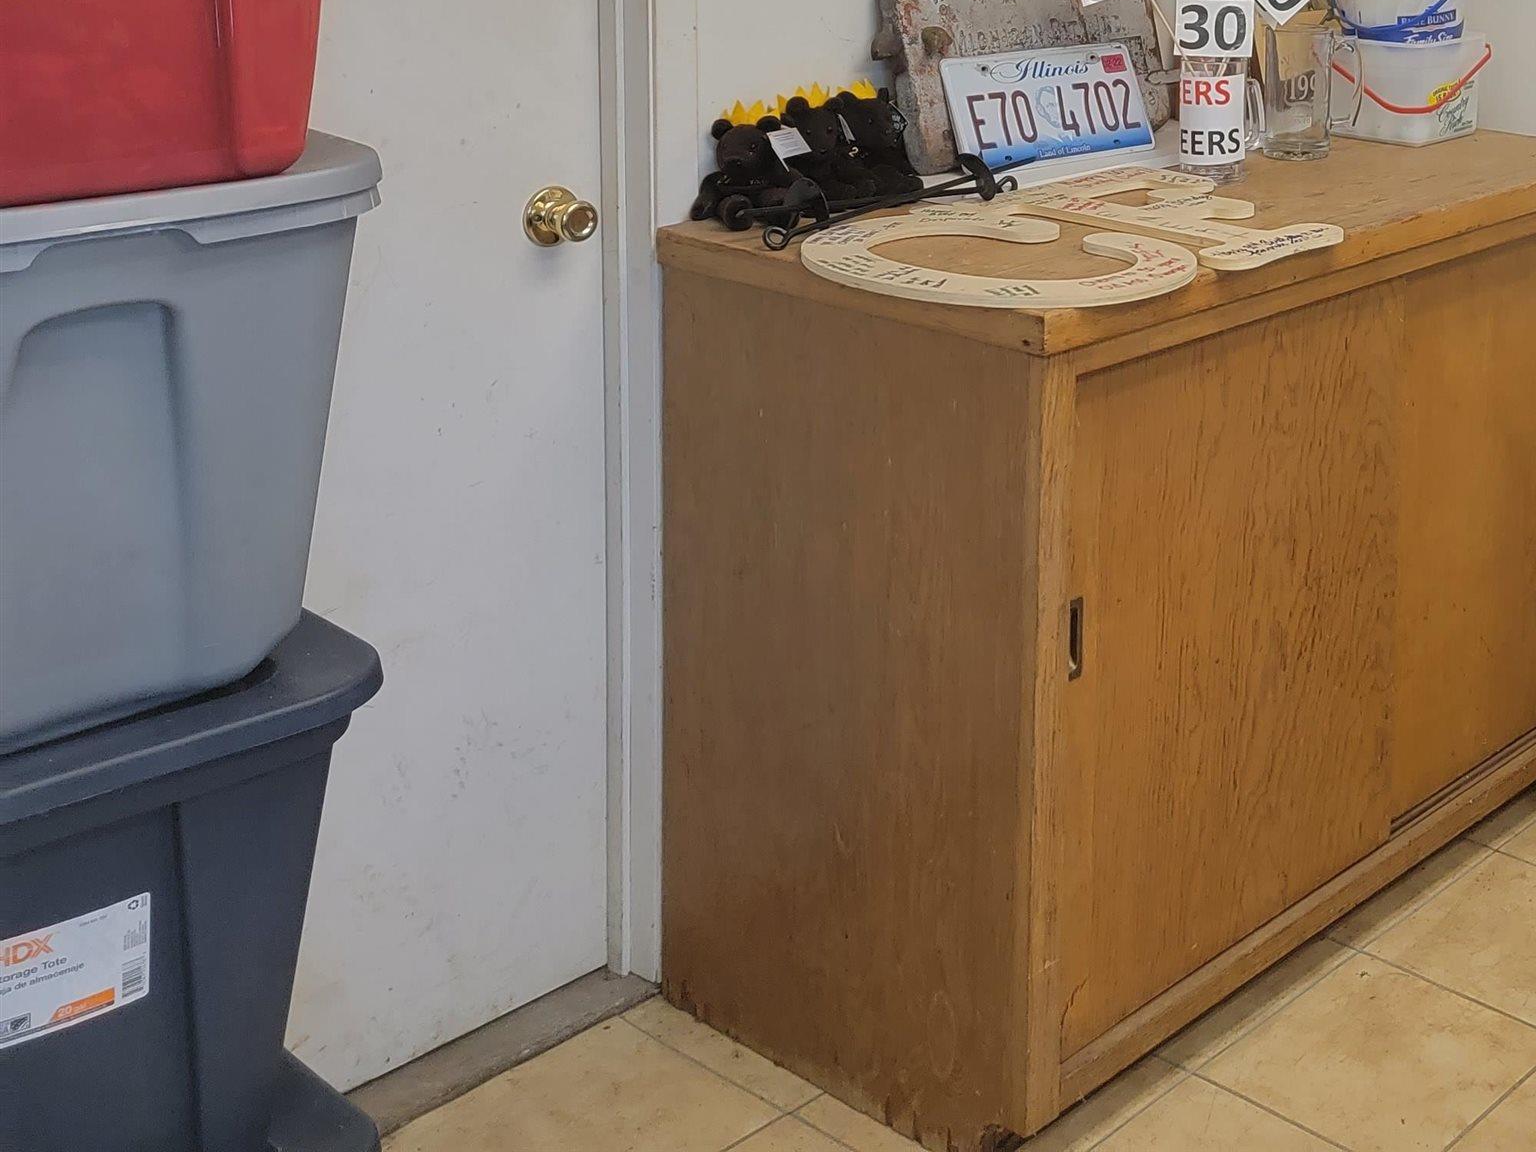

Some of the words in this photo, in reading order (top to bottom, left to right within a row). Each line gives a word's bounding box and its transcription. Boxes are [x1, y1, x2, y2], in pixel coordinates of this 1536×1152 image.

[1178, 4, 1247, 51] 30
[1427, 12, 1454, 25] BUNNY
[992, 56, 1089, 83] Illinois
[966, 90, 1038, 150] E70
[1056, 78, 1142, 137] 4702
[1039, 148, 1057, 158] Land
[1057, 146, 1066, 155] of
[1066, 143, 1091, 154] Lincoln
[14, 981, 27, 990] de
[29, 962, 84, 986] almacenaje
[41, 957, 67, 970] Tote
